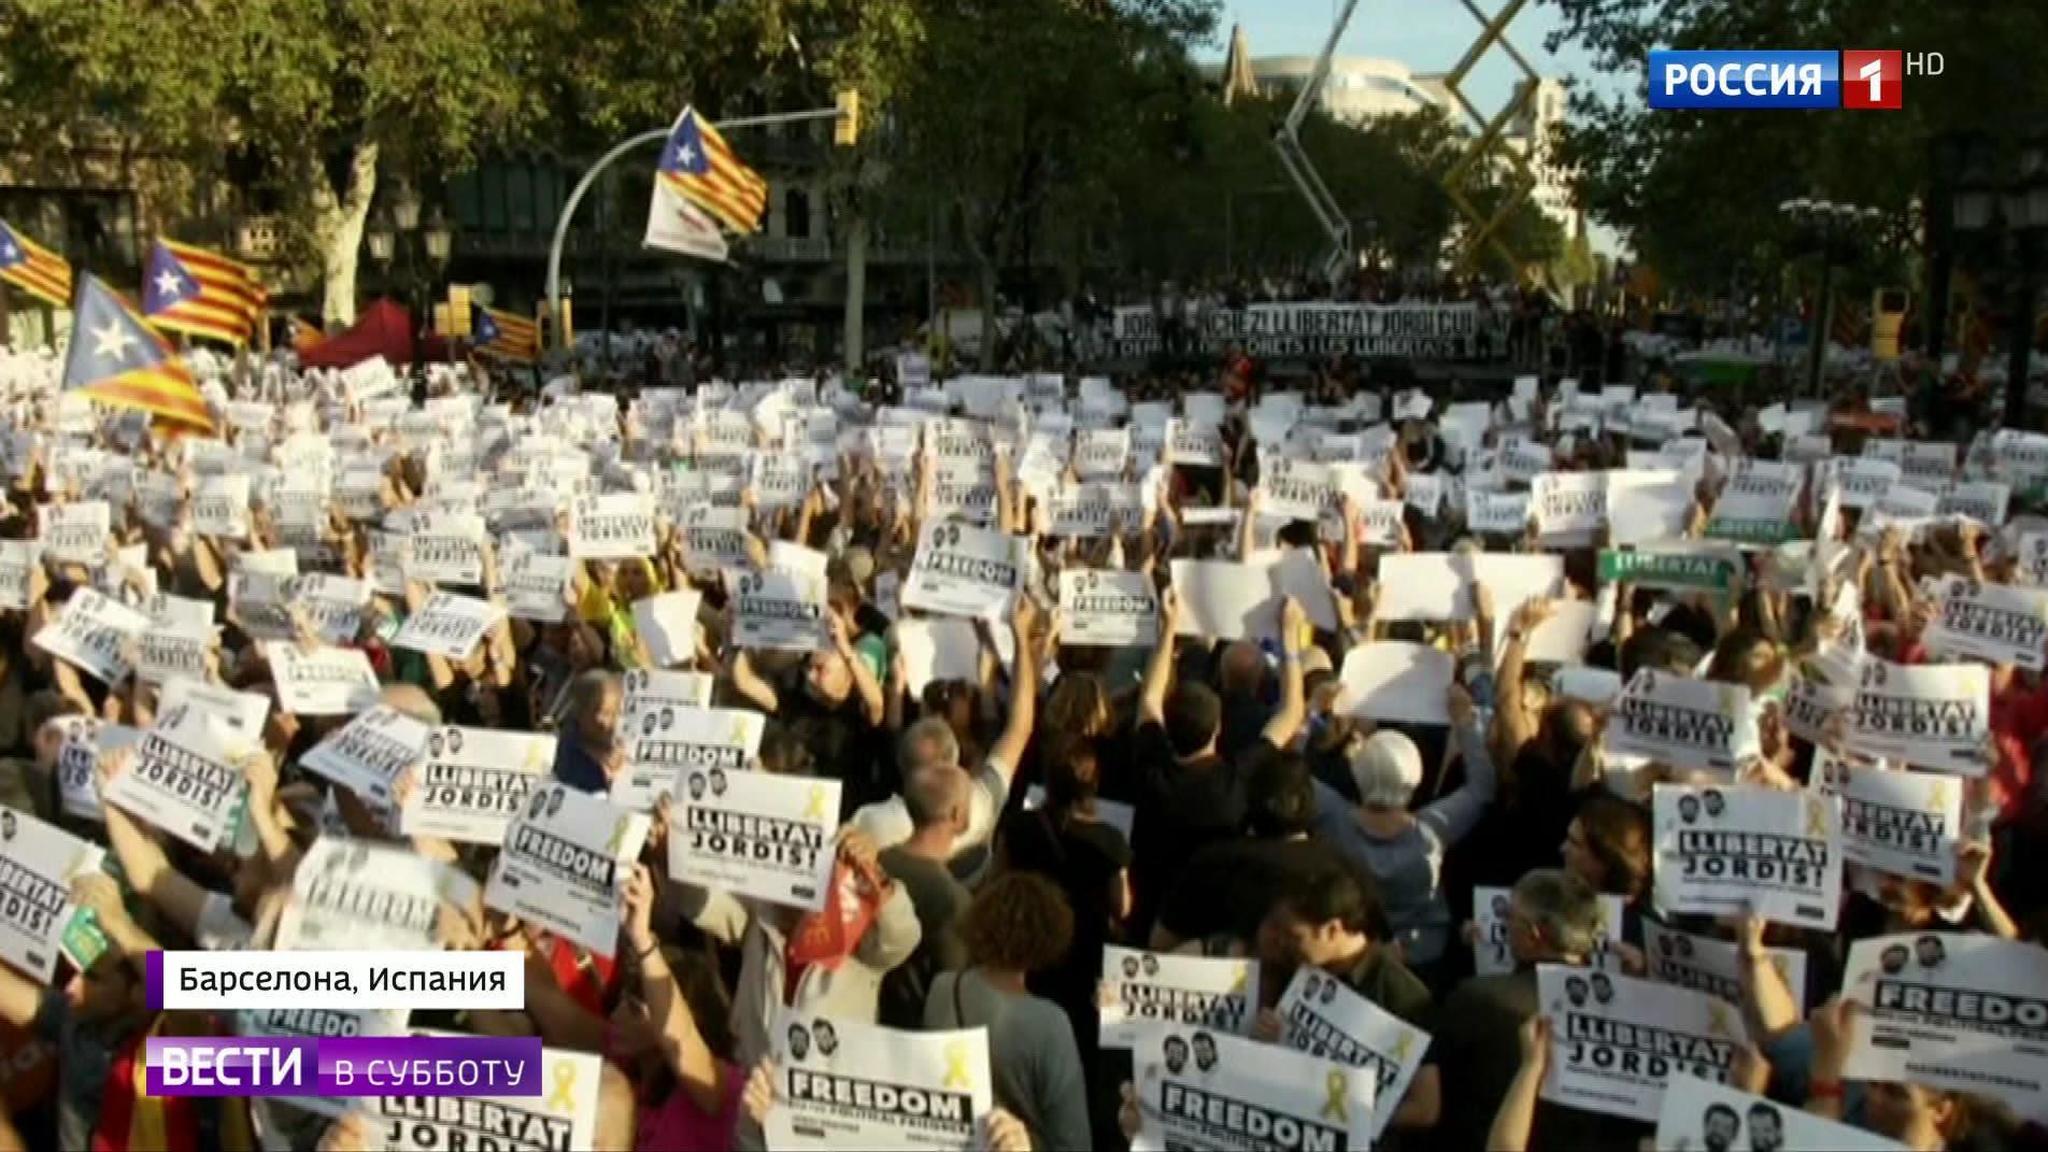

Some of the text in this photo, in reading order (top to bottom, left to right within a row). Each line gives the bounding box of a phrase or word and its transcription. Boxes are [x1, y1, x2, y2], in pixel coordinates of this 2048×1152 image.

[1855, 709, 1973, 736] JORDIS!
[636, 739, 745, 769] FREEDOM
[136, 755, 224, 811] JORDIS!
[425, 786, 521, 813] JORDIS
[687, 805, 823, 850] LLIBERTAT
[516, 825, 616, 889] FREEDOM
[690, 831, 817, 869] JORDIS!
[1679, 830, 1828, 867] LLIBERTAT
[1683, 856, 1823, 888] JORDIS!
[1121, 983, 1246, 1017] LLIBERTAT
[1875, 980, 2048, 1034] FREEDO
[268, 1008, 361, 1037] FREEDO
[1567, 1011, 1735, 1070] LLIBERTAT
[788, 1068, 973, 1124] FREEDOM
[1161, 1080, 1349, 1152] FREEDOM
[380, 1096, 572, 1152] LLIBERTAT
